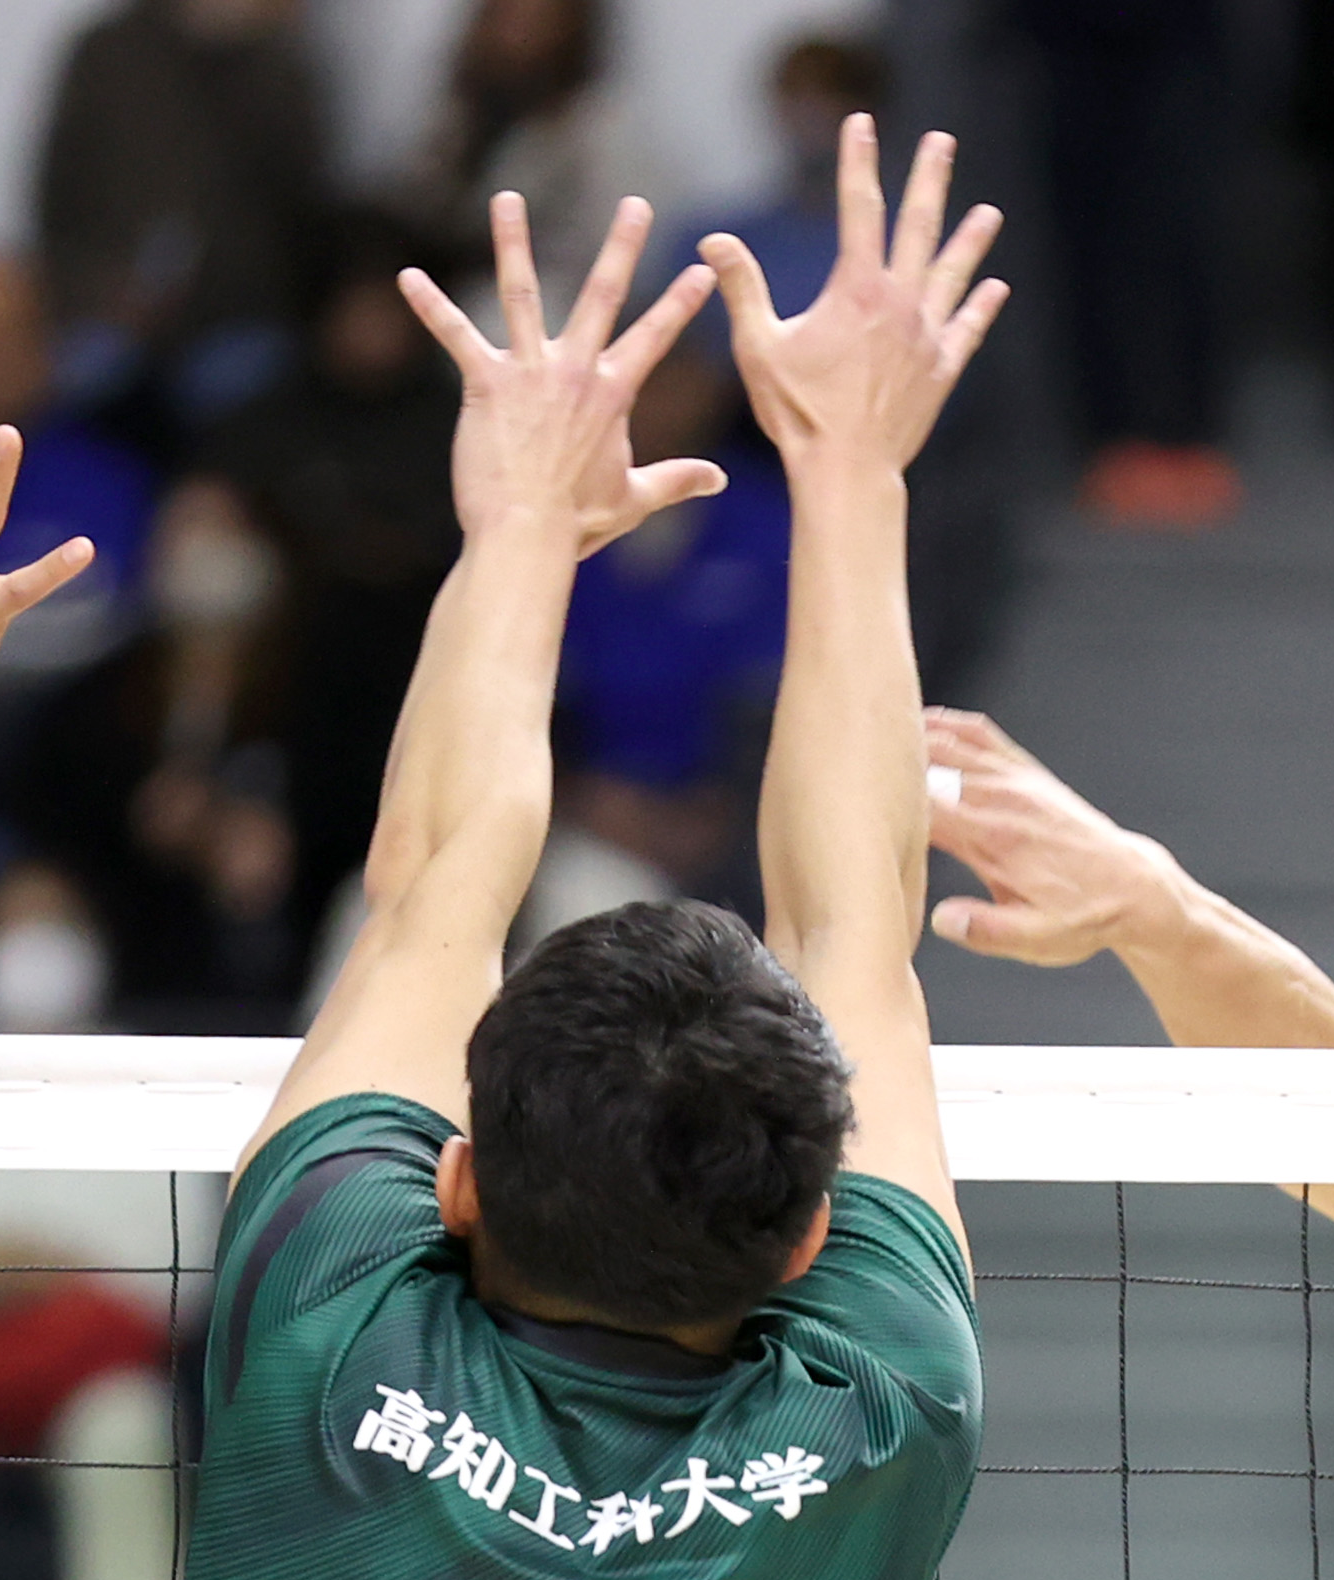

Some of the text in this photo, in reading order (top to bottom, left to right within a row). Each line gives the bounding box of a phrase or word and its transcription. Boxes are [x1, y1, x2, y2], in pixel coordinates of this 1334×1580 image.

[353, 1383, 829, 1556] 高知工科大学
